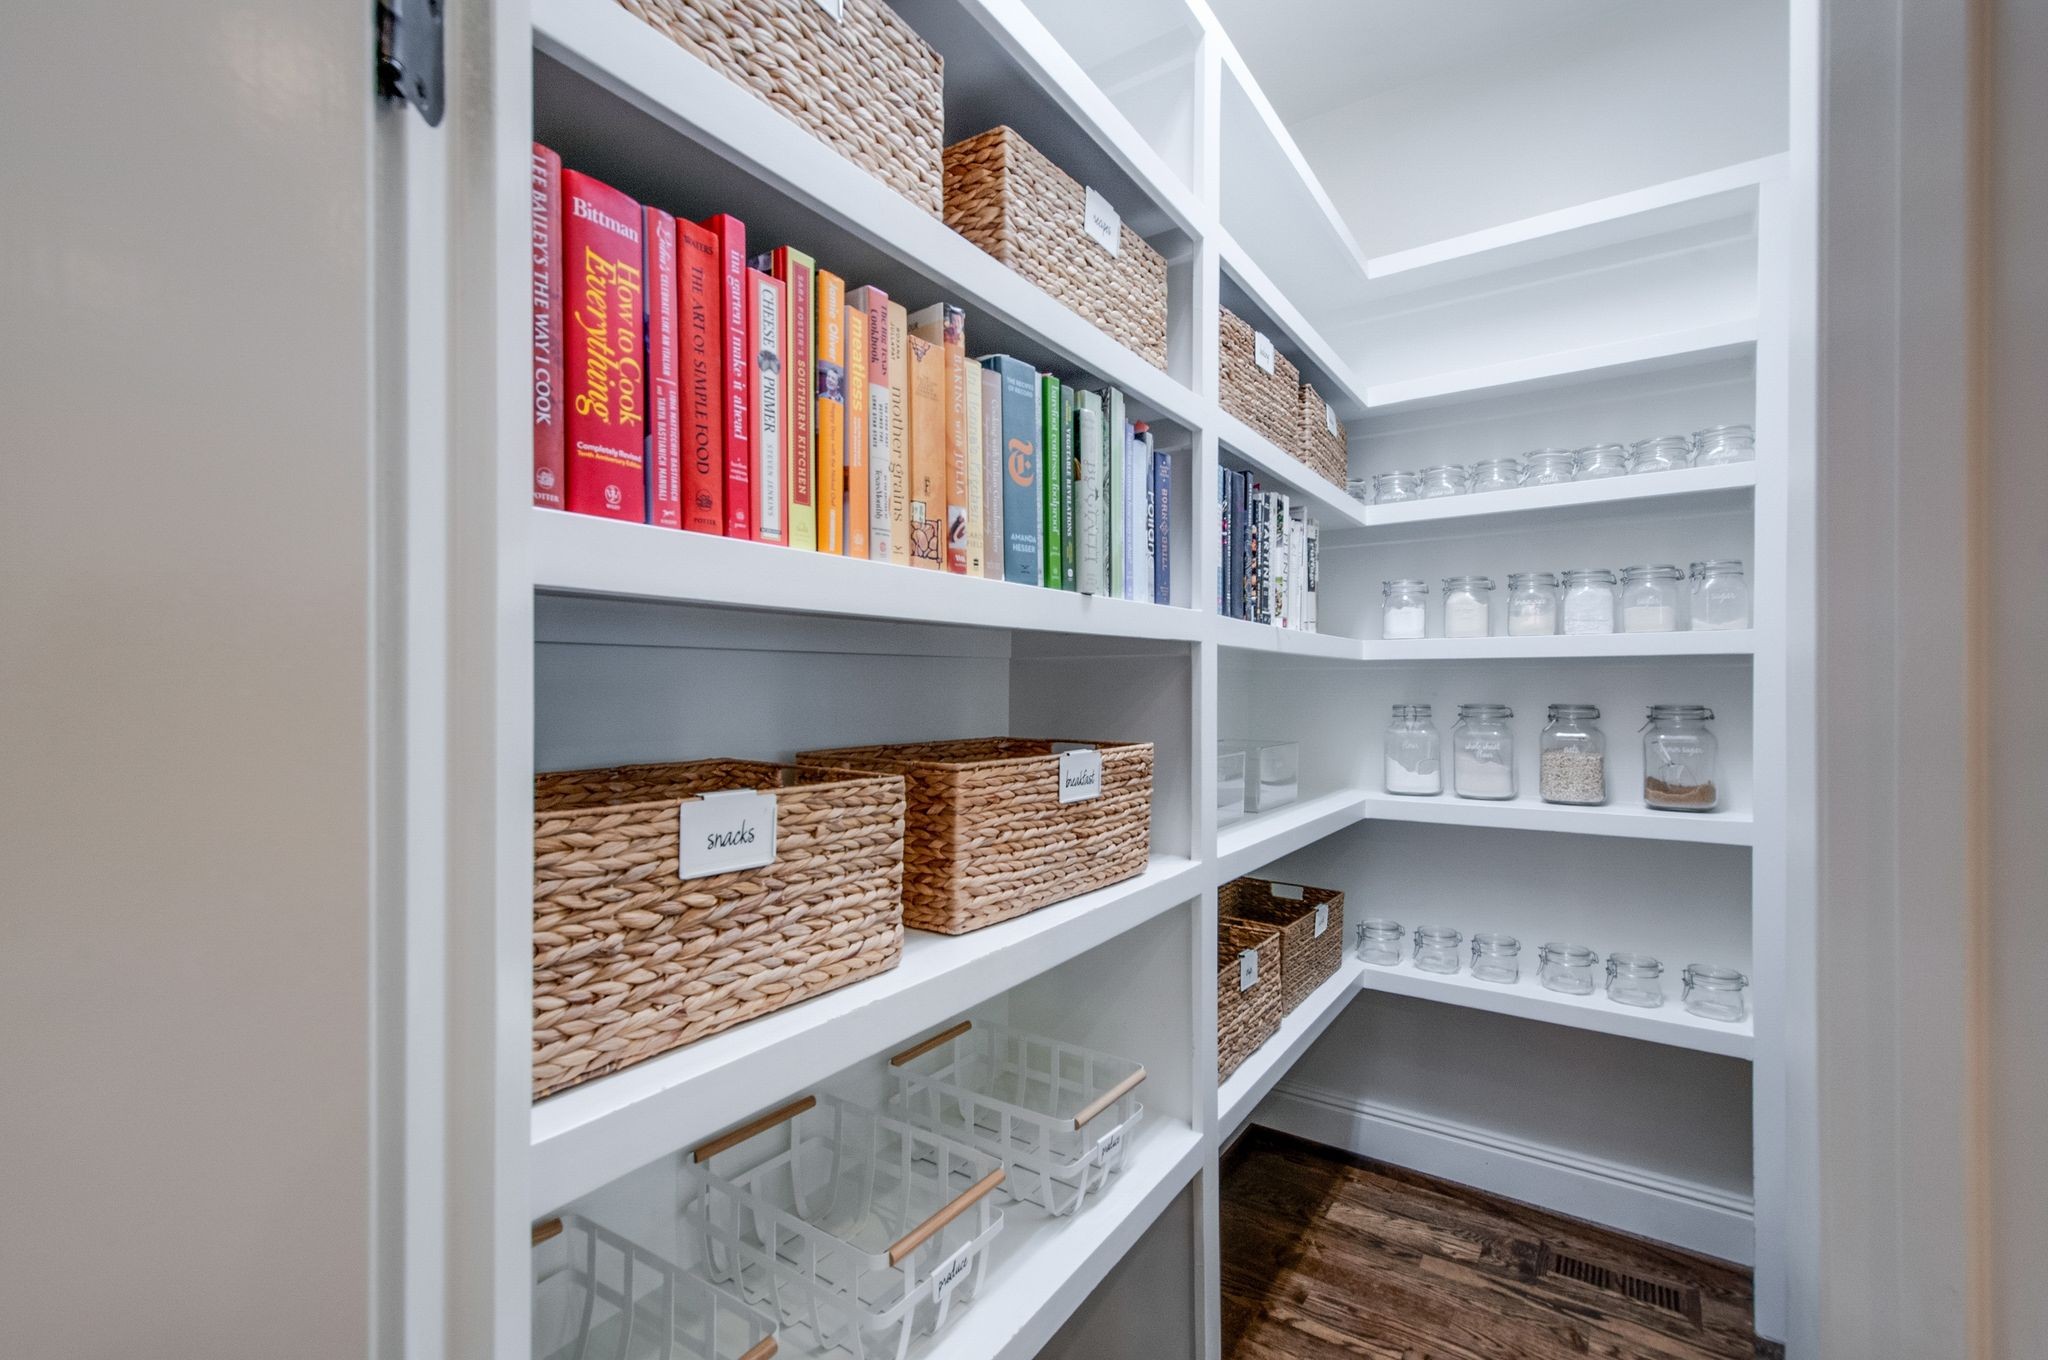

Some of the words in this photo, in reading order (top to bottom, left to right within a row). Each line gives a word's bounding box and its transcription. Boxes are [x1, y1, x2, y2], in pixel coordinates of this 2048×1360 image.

[532, 154, 547, 187] LEE
[532, 189, 548, 267] BAILEY'S
[572, 196, 639, 243] Bittman
[656, 220, 672, 272] Lidia's
[731, 250, 744, 273] ina
[533, 271, 549, 309] THE
[617, 259, 640, 326] How
[660, 274, 670, 315] CELEBRATE
[691, 267, 703, 295] THE
[727, 274, 743, 327] garten
[534, 313, 549, 353] WAY
[575, 245, 619, 425] Everything
[661, 317, 670, 332] LIKE
[692, 298, 706, 333] ART
[762, 289, 775, 349] CHEESE
[870, 309, 880, 363] Cookbook
[535, 354, 550, 364] I
[617, 326, 637, 353] to
[662, 333, 670, 346] AN
[662, 347, 671, 376] ITALIAN
[693, 334, 706, 356] OF
[732, 337, 747, 377] make
[828, 323, 839, 361] Oliver
[733, 379, 746, 392] it
[852, 316, 866, 412] meatless
[954, 354, 963, 413] BAKING
[535, 368, 551, 425] COOK
[618, 357, 642, 426] Cook
[694, 357, 708, 419] SIMPLE
[763, 376, 776, 433] PRIMER
[797, 360, 806, 431] SOUTHERN
[1051, 385, 1059, 431] barefoot
[733, 394, 748, 441] ahead
[892, 387, 904, 459] mother
[577, 441, 618, 458] Completely
[618, 449, 642, 462] Revised
[695, 423, 710, 475] FOOD
[798, 434, 807, 495] KITCHEN
[889, 461, 904, 522] grains
[953, 451, 964, 496] JULIA
[533, 491, 561, 503] OTTER
[766, 479, 777, 516] JENKINS
[1049, 483, 1060, 535] foolproof
[1011, 533, 1037, 543] AMANDA
[1012, 543, 1036, 553] HESSER
[707, 819, 755, 850] snacks
